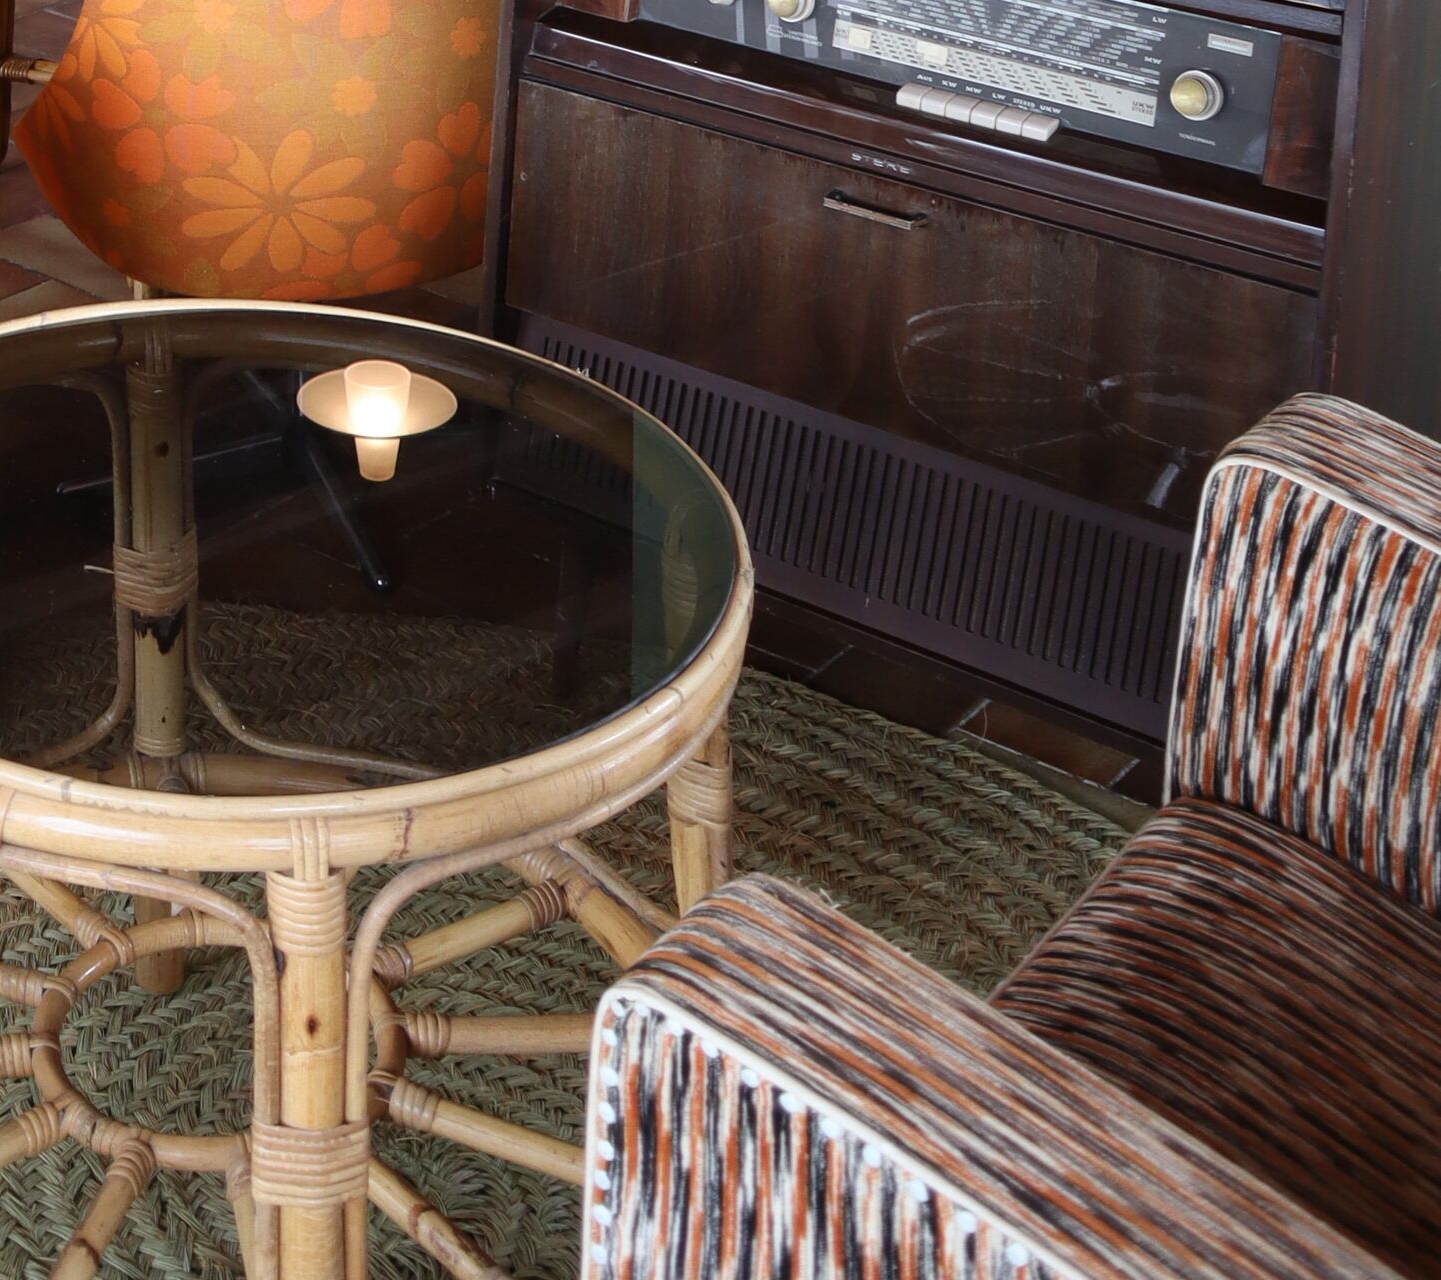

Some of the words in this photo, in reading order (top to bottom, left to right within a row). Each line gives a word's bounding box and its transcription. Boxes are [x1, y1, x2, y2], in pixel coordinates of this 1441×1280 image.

[1152, 16, 1167, 24] LW
[1144, 56, 1162, 65] MW
[941, 79, 957, 88] KW
[965, 85, 982, 94] MW
[992, 92, 1006, 100] LW
[1039, 104, 1062, 114] UKW
[1132, 100, 1155, 110] UKW
